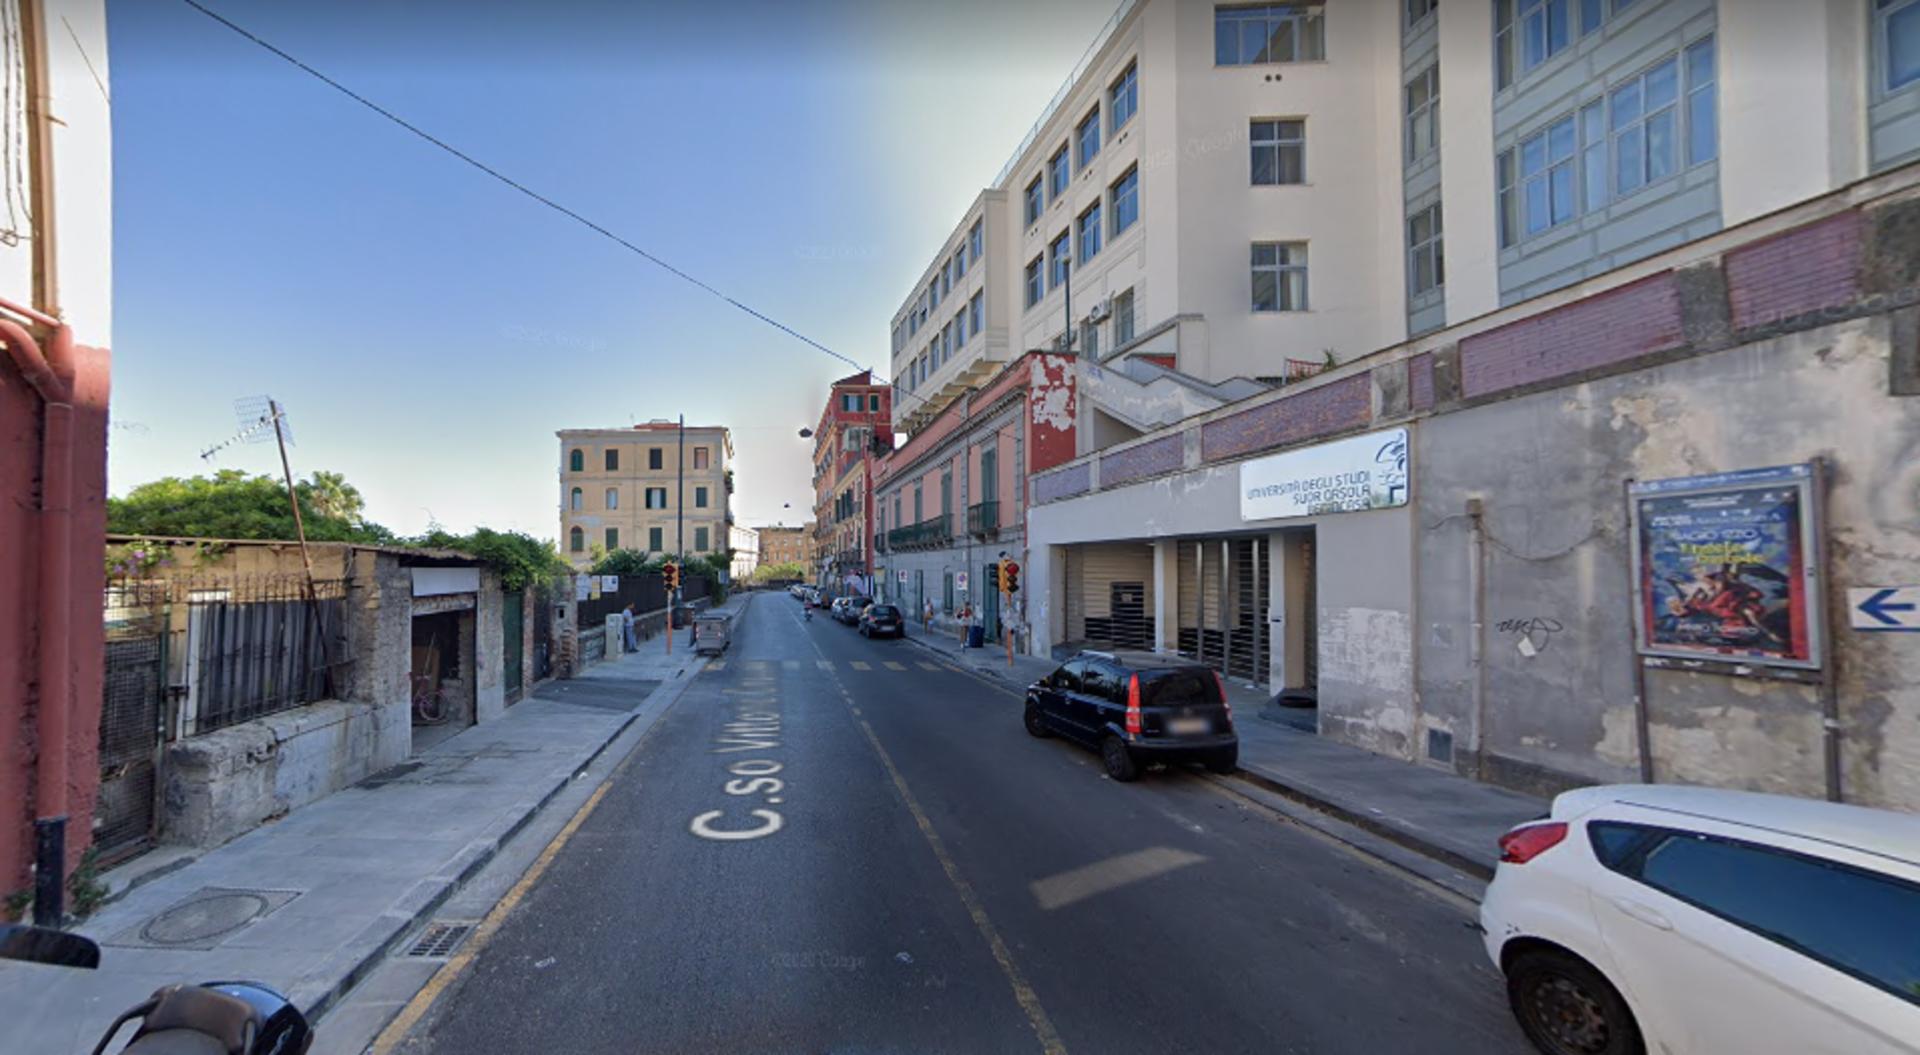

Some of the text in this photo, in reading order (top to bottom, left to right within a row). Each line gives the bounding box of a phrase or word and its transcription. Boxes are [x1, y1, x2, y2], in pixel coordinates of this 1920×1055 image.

[1302, 477, 1332, 492] DEGLI
[1336, 470, 1370, 488] STUDI
[1293, 491, 1321, 506] SUOR
